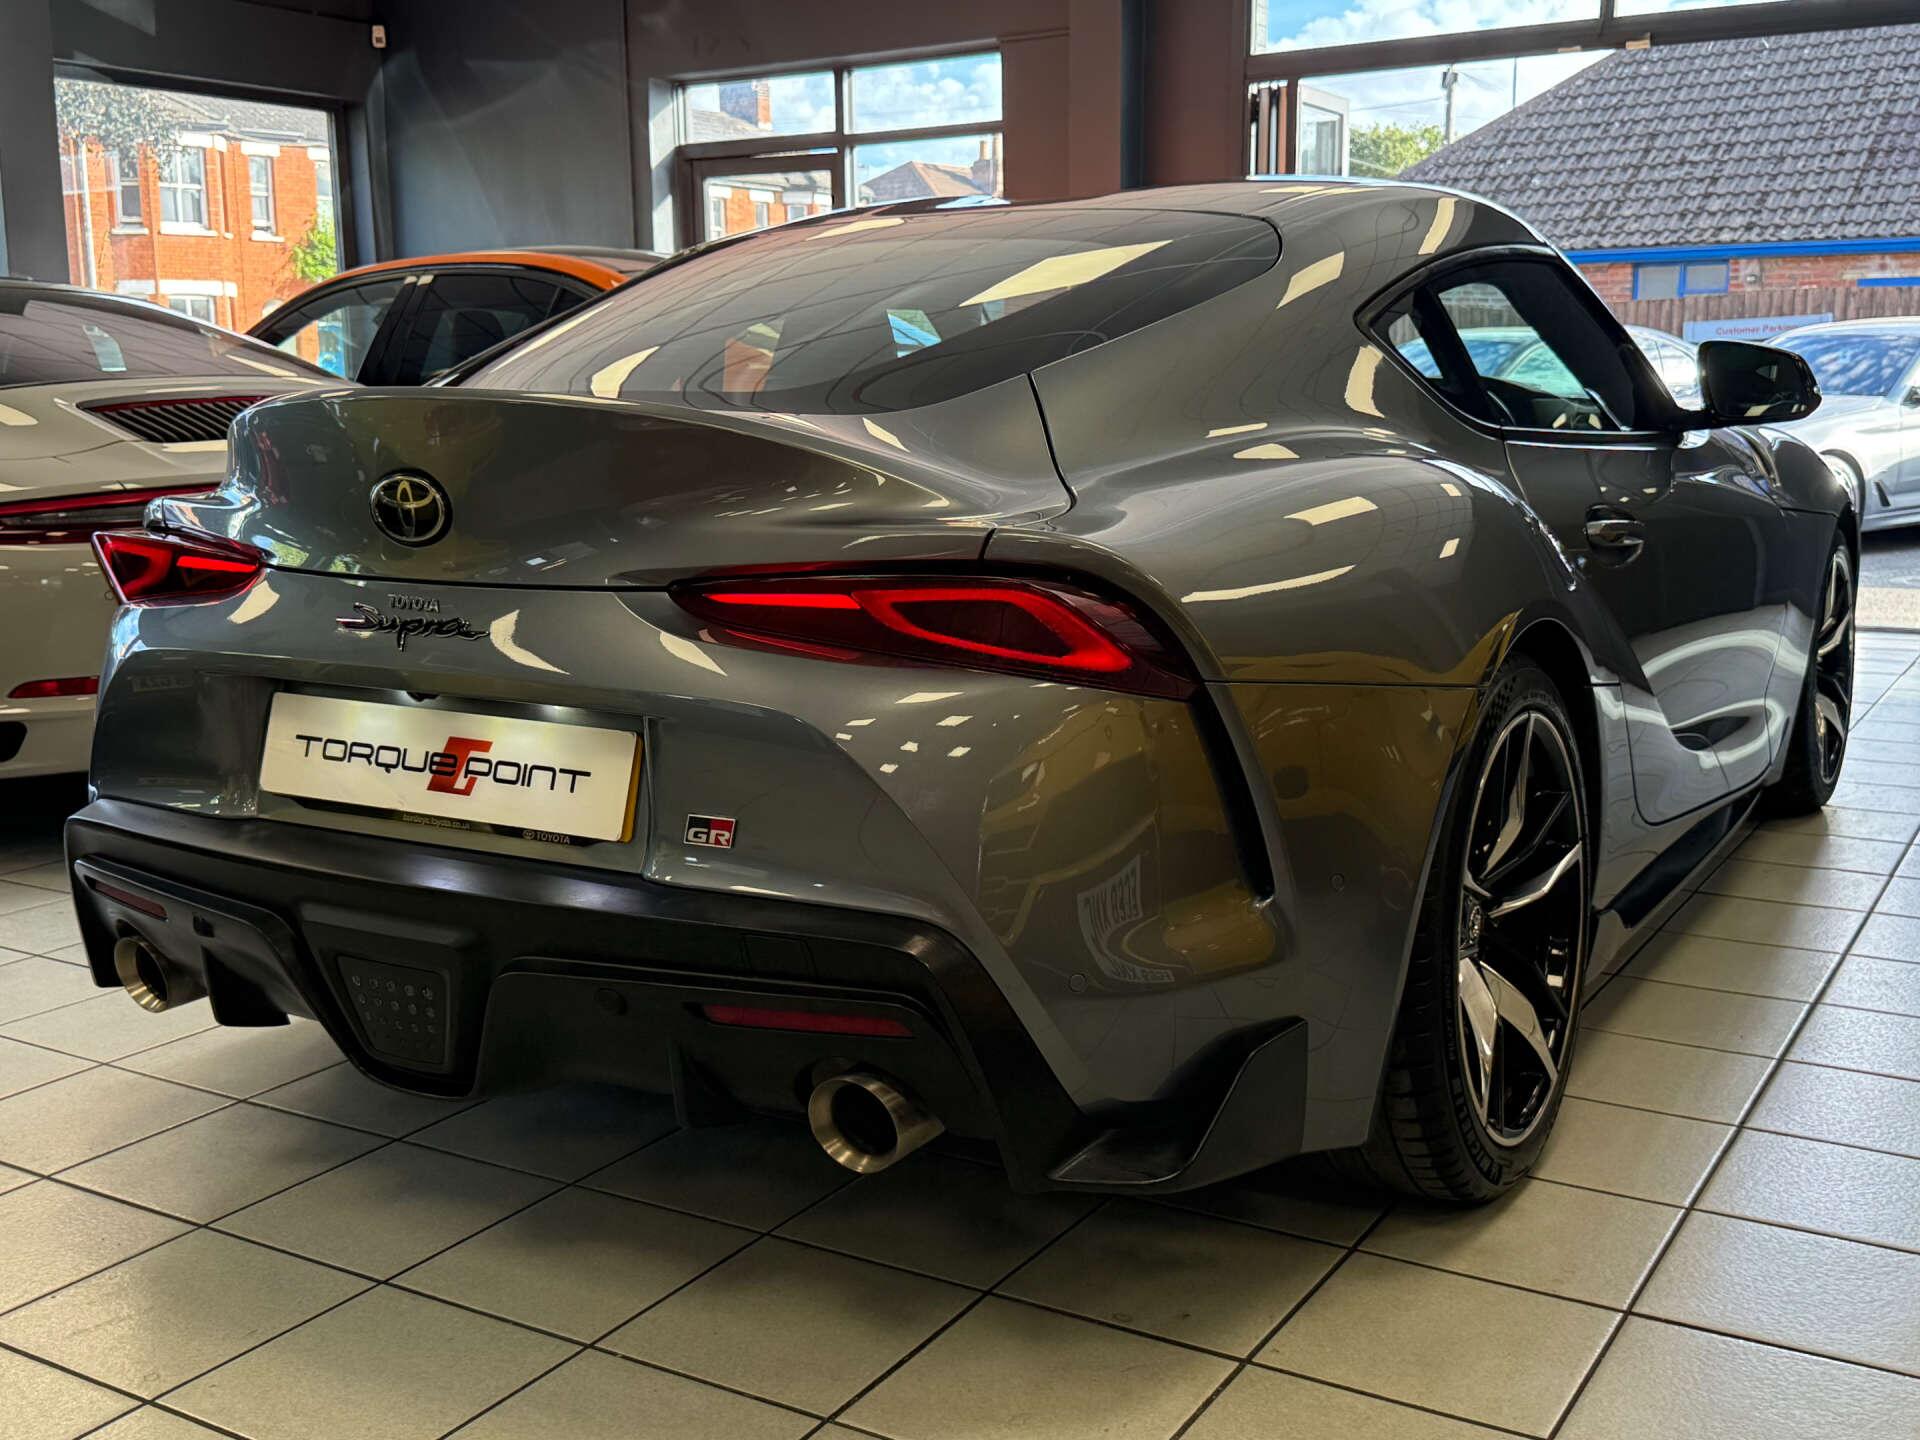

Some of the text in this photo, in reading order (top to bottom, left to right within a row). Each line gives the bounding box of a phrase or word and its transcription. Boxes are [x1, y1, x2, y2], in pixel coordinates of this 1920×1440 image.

[1715, 327, 1760, 336] Customer
[387, 593, 440, 613] TOYOTA
[336, 602, 489, 652] Supra
[535, 829, 571, 845] TOYOTA
[687, 827, 731, 846] GR
